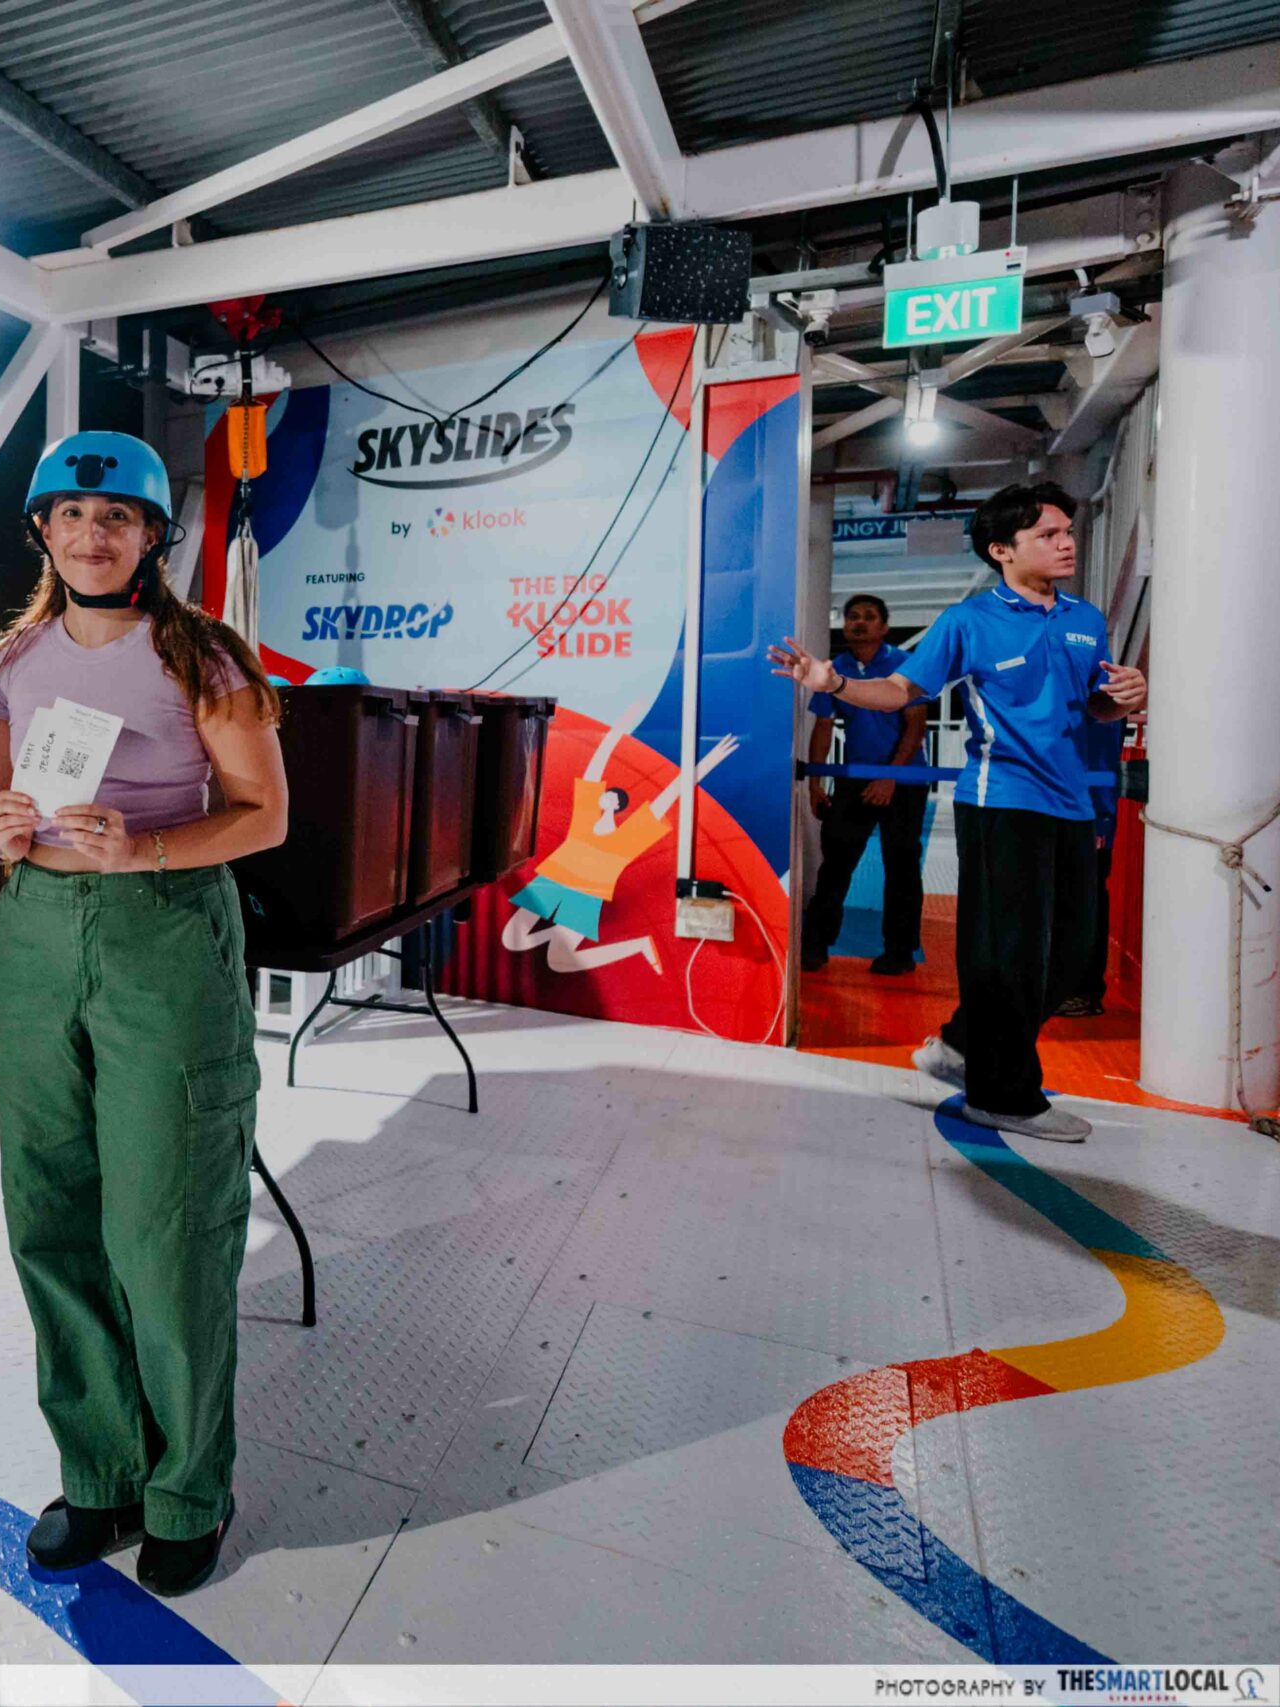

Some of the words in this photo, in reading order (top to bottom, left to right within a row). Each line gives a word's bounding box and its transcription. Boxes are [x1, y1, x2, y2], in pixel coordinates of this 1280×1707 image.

[906, 286, 997, 336] EXIT
[354, 403, 575, 473] SKYSLIDES
[391, 521, 411, 538] by
[463, 508, 527, 530] klook
[833, 520, 886, 537] UNGY
[306, 572, 365, 584] FEATURING
[510, 576, 556, 596] THE
[563, 573, 607, 594] BIG
[302, 602, 454, 641] SKYDROP
[507, 597, 632, 629] KLOOK
[537, 628, 632, 658] SLIDE
